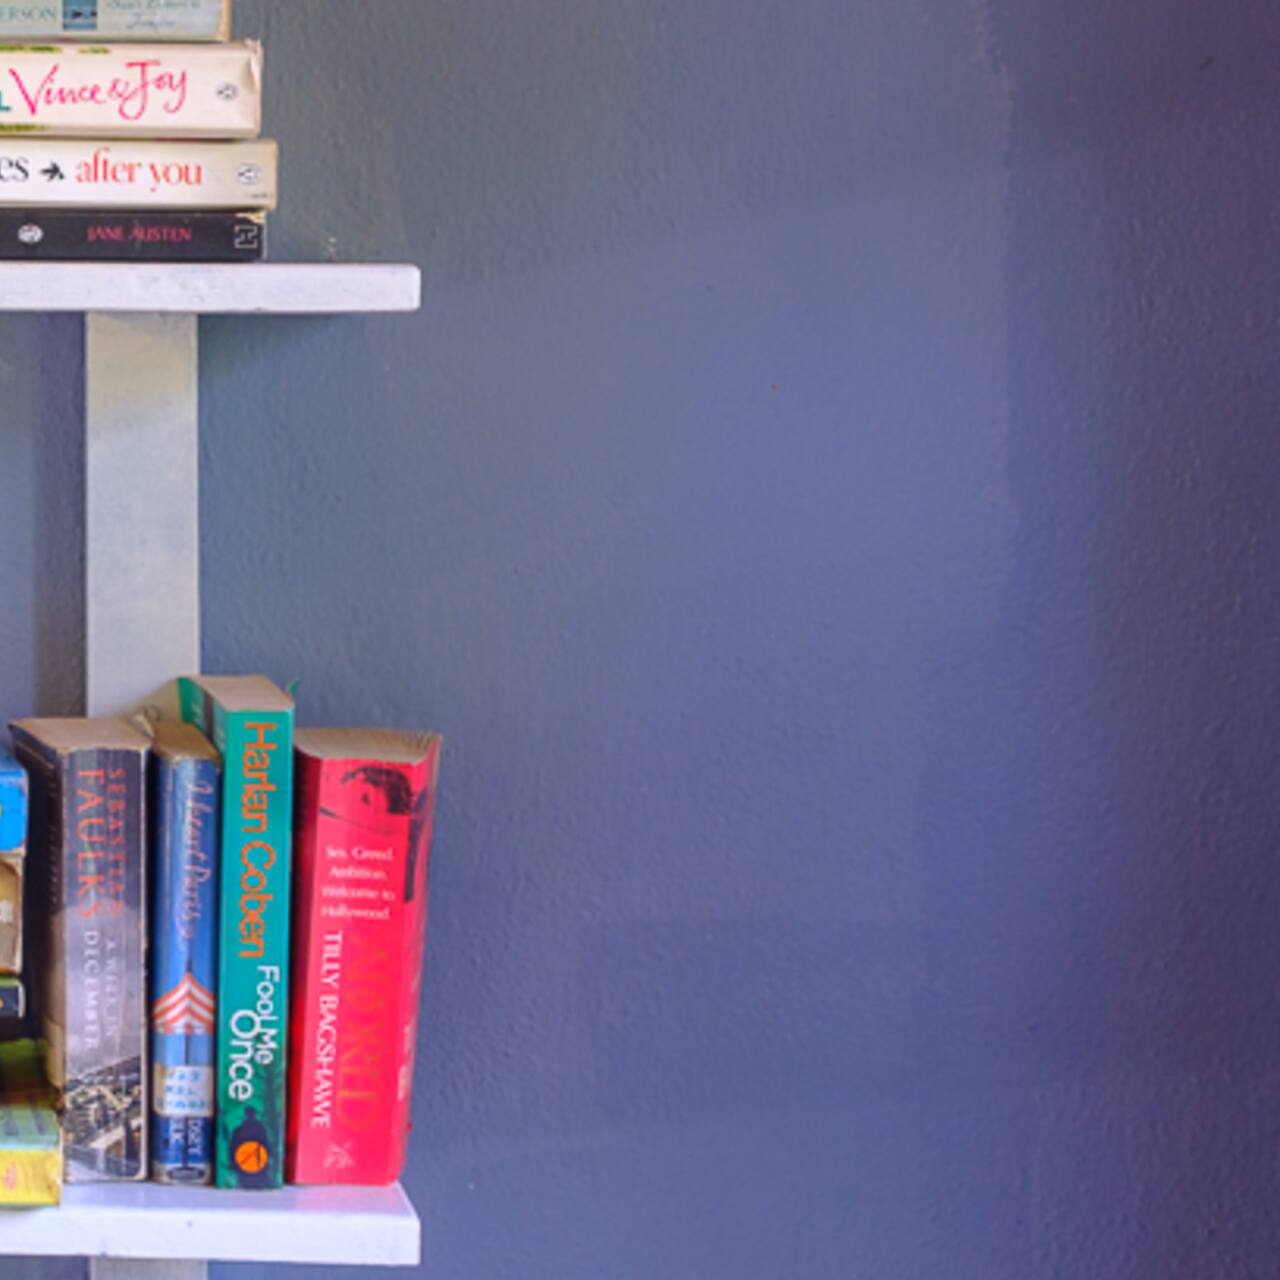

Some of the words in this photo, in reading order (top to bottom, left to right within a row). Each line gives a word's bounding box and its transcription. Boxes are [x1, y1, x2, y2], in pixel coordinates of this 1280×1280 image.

[75, 147, 143, 184] after
[149, 159, 203, 193] you
[87, 226, 126, 242] JANE
[127, 226, 192, 242] AUSTEN
[243, 722, 277, 835] Harlan
[75, 767, 106, 919] FAULKS
[106, 767, 128, 917] SEBASTIAN
[238, 840, 277, 959] Coben
[82, 929, 100, 1050] DECEMBER
[255, 964, 281, 1021] Fool
[320, 930, 344, 990] TILLY
[228, 1009, 260, 1103] Once
[255, 1022, 279, 1066] Me
[310, 994, 339, 1129] BAGSHAWE
